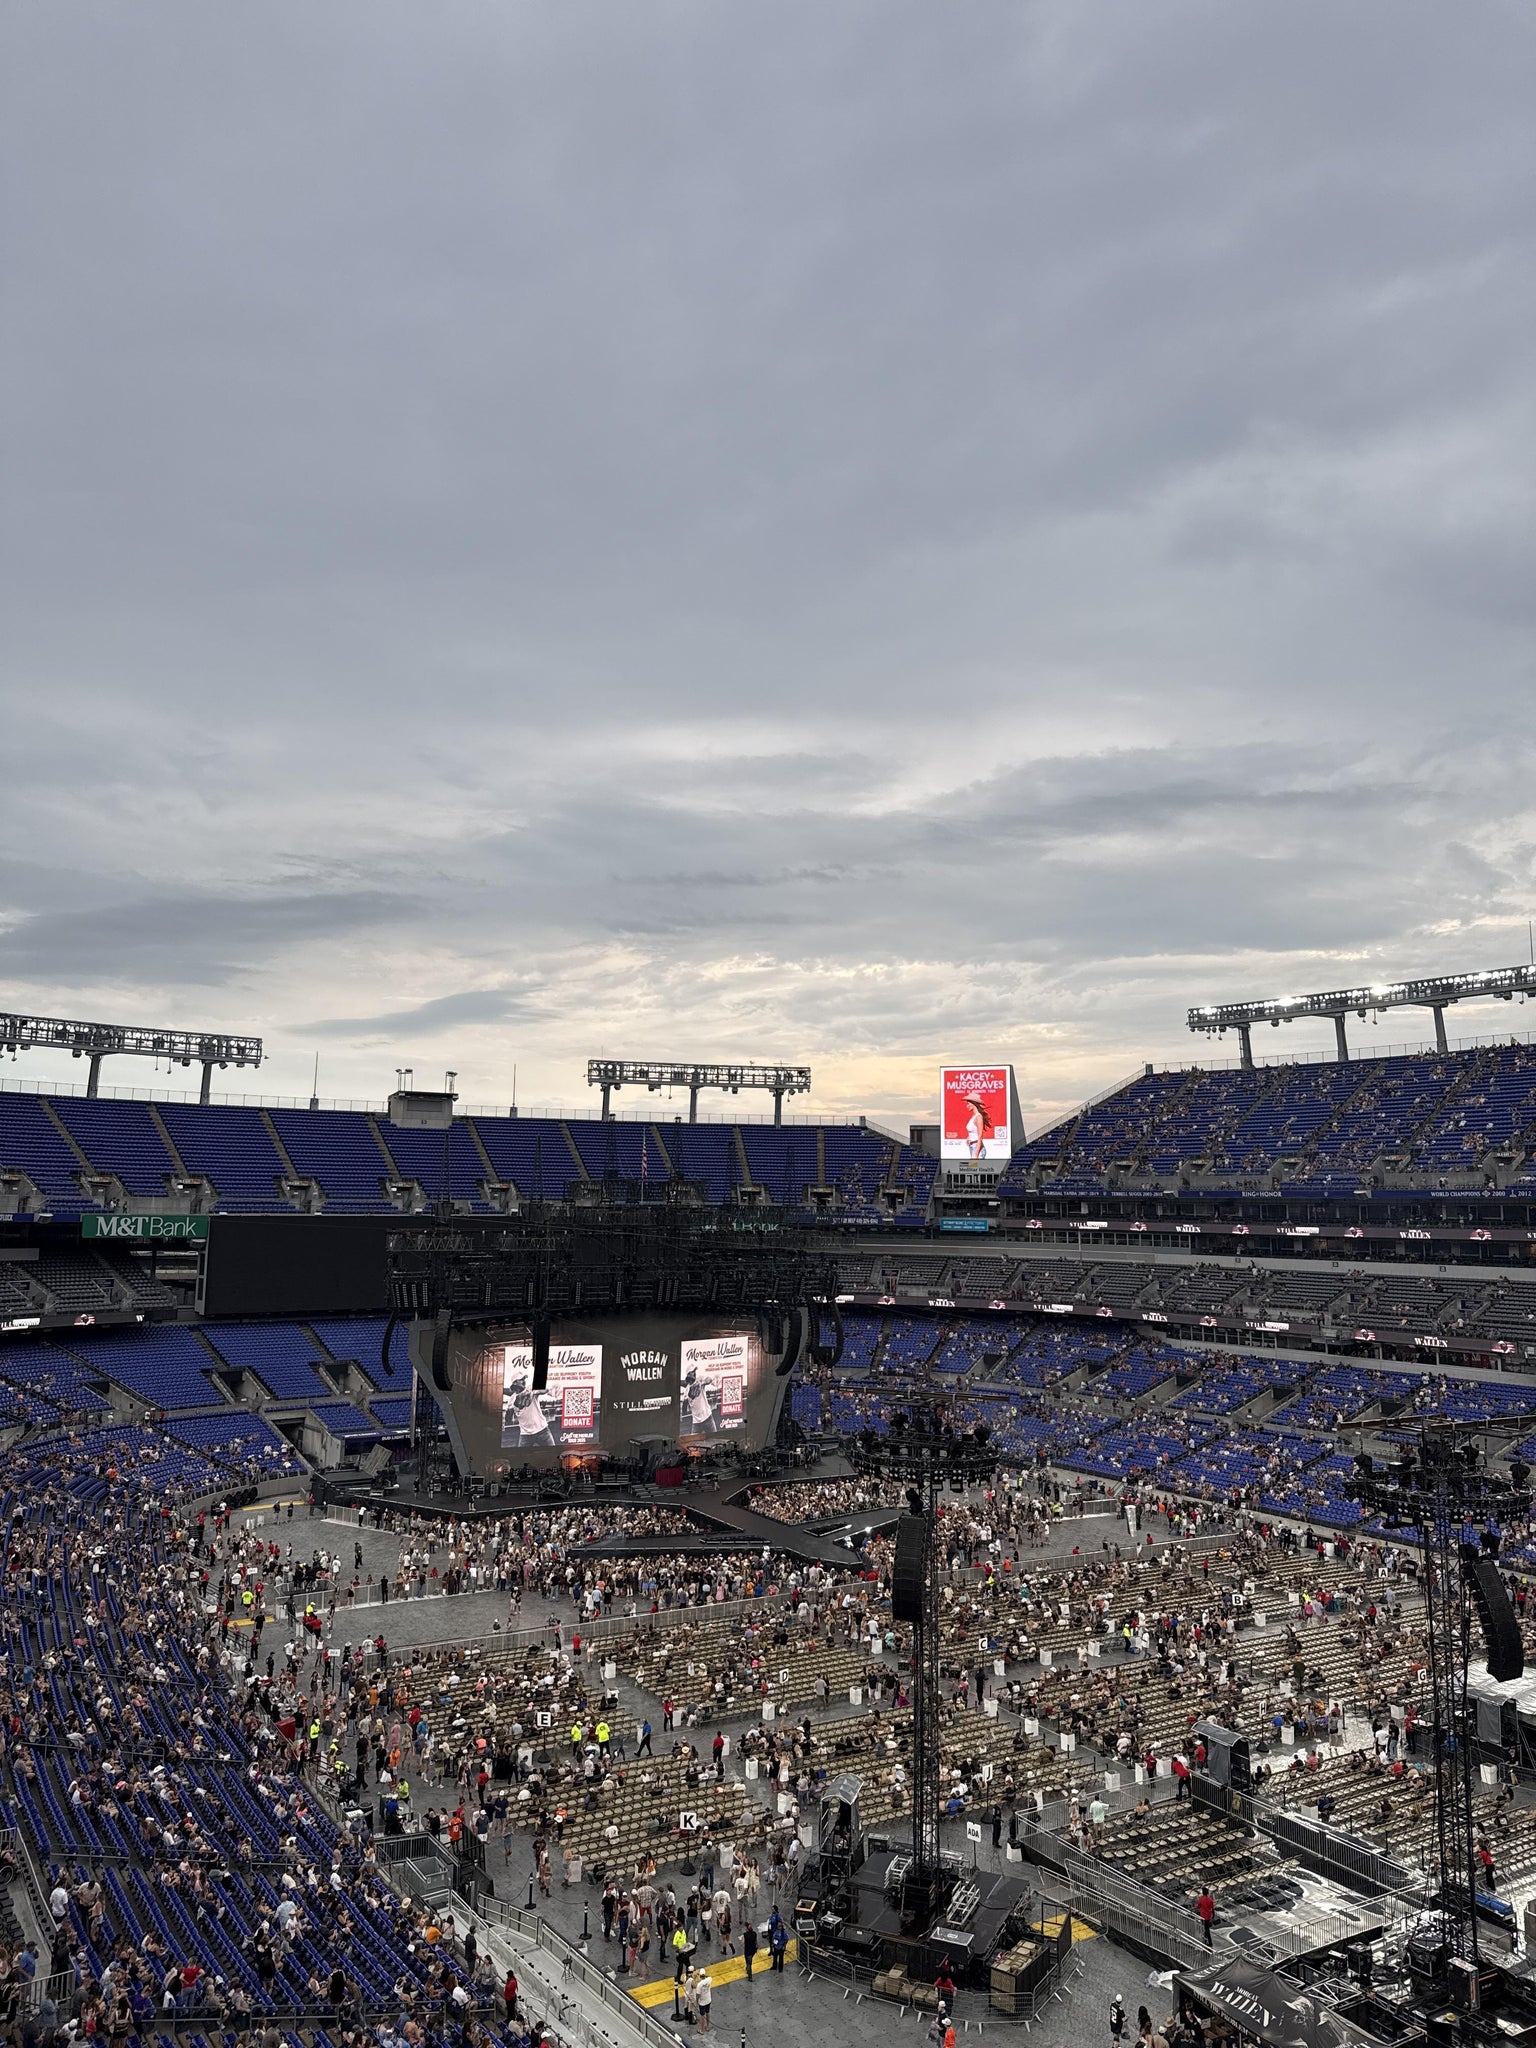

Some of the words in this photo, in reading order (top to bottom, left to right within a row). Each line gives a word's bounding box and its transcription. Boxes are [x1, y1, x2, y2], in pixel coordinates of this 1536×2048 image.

[960, 1072, 991, 1081] KACEY
[947, 1080, 1004, 1090] MUSGRAVES
[96, 1216, 148, 1237] M&T
[151, 1216, 196, 1237] Bank
[1142, 1313, 1168, 1322] WALLEN
[1414, 1337, 1448, 1348] WALLEN
[686, 1347, 716, 1361] Morgan
[717, 1342, 744, 1359] Wallen
[557, 1350, 595, 1367] Wallen
[620, 1350, 668, 1369] MORGAN
[627, 1366, 663, 1381] WALLEN
[613, 1401, 643, 1409] STILL
[722, 1404, 741, 1413] DONATE
[563, 1417, 591, 1427] DONATE
[1380, 1568, 1387, 1577] A
[1234, 1596, 1241, 1604] B
[981, 1639, 987, 1650] C
[782, 1671, 788, 1682] D
[1420, 1670, 1426, 1681] G
[541, 1714, 548, 1725] E
[986, 1767, 991, 1780] J
[684, 1815, 694, 1828] K
[968, 1827, 980, 1838] ADA
[1210, 1981, 1277, 2027] WALLEN
